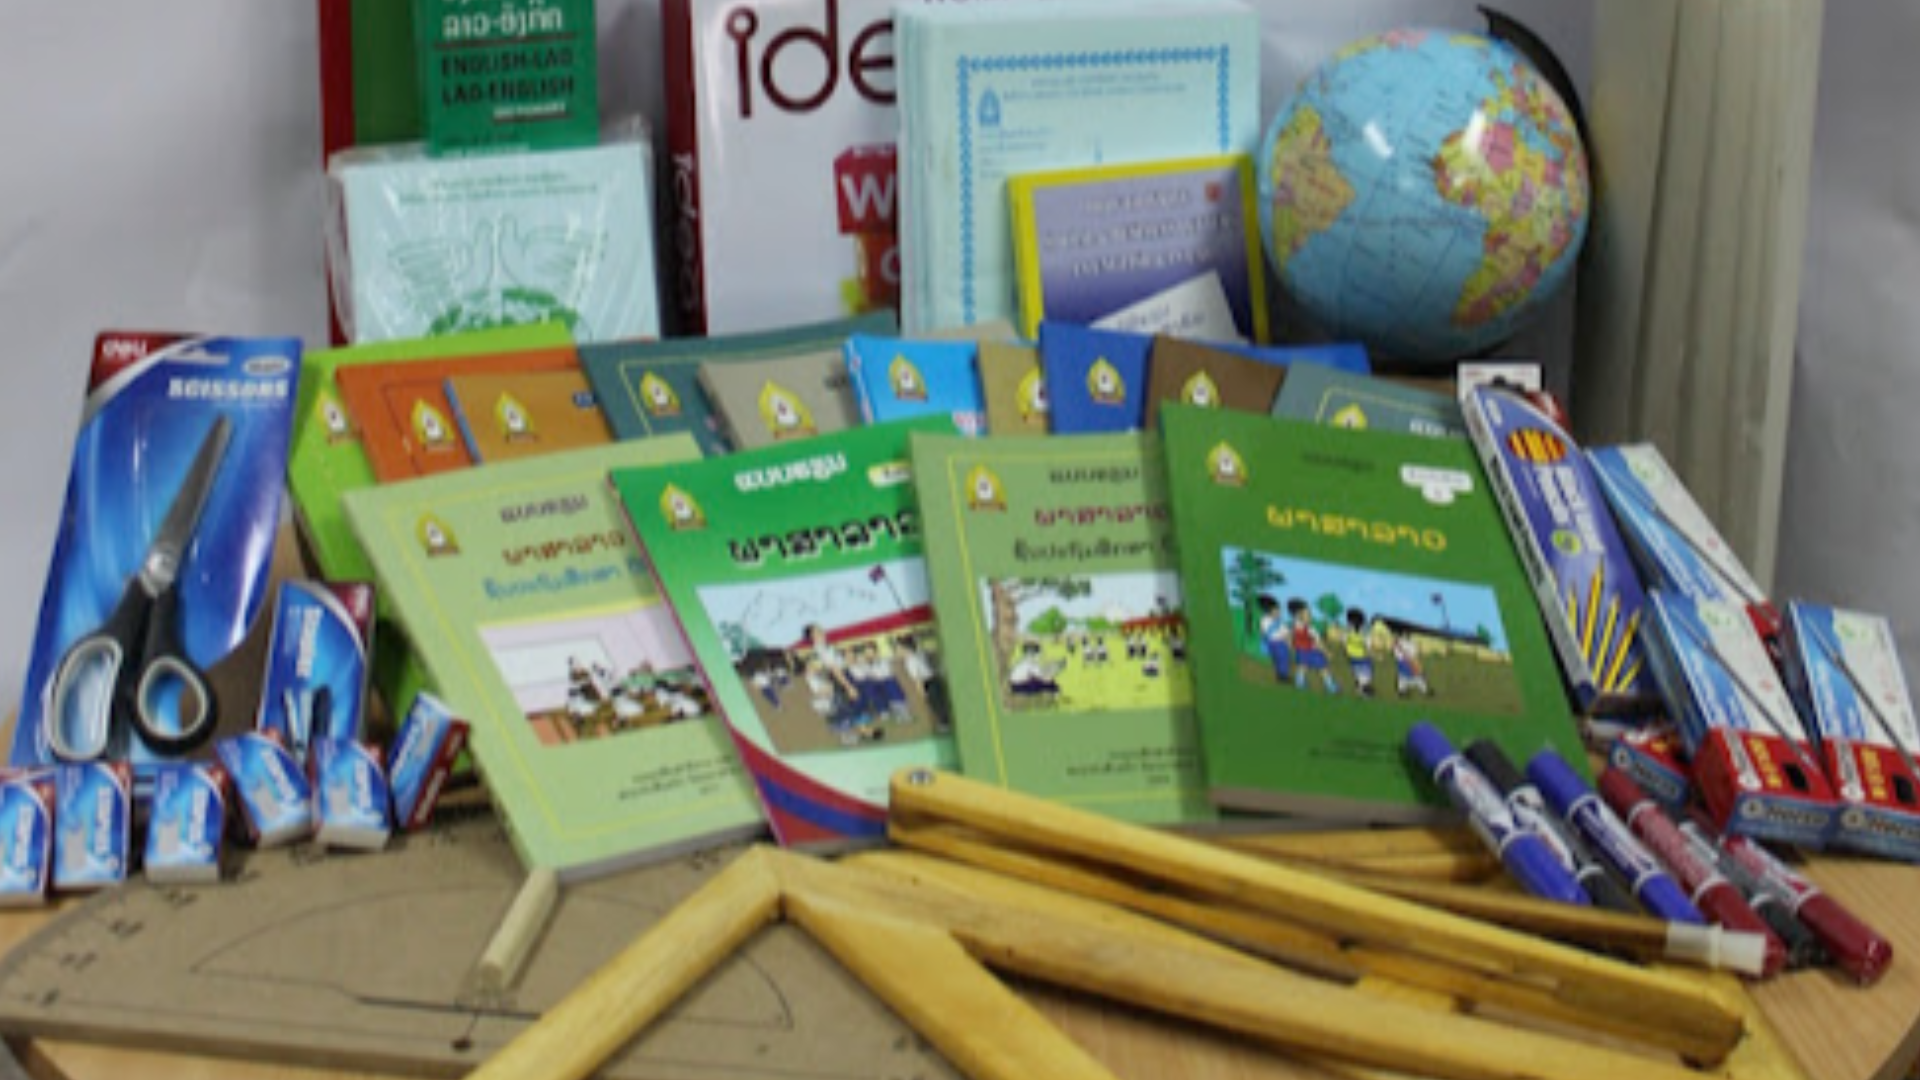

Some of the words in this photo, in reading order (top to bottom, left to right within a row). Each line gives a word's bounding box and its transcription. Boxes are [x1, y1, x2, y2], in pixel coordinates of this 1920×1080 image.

[441, 47, 574, 78] ENGLISH-LAO
[441, 75, 575, 108] LAO-ENGLISH
[169, 377, 290, 400] SCISSORS
